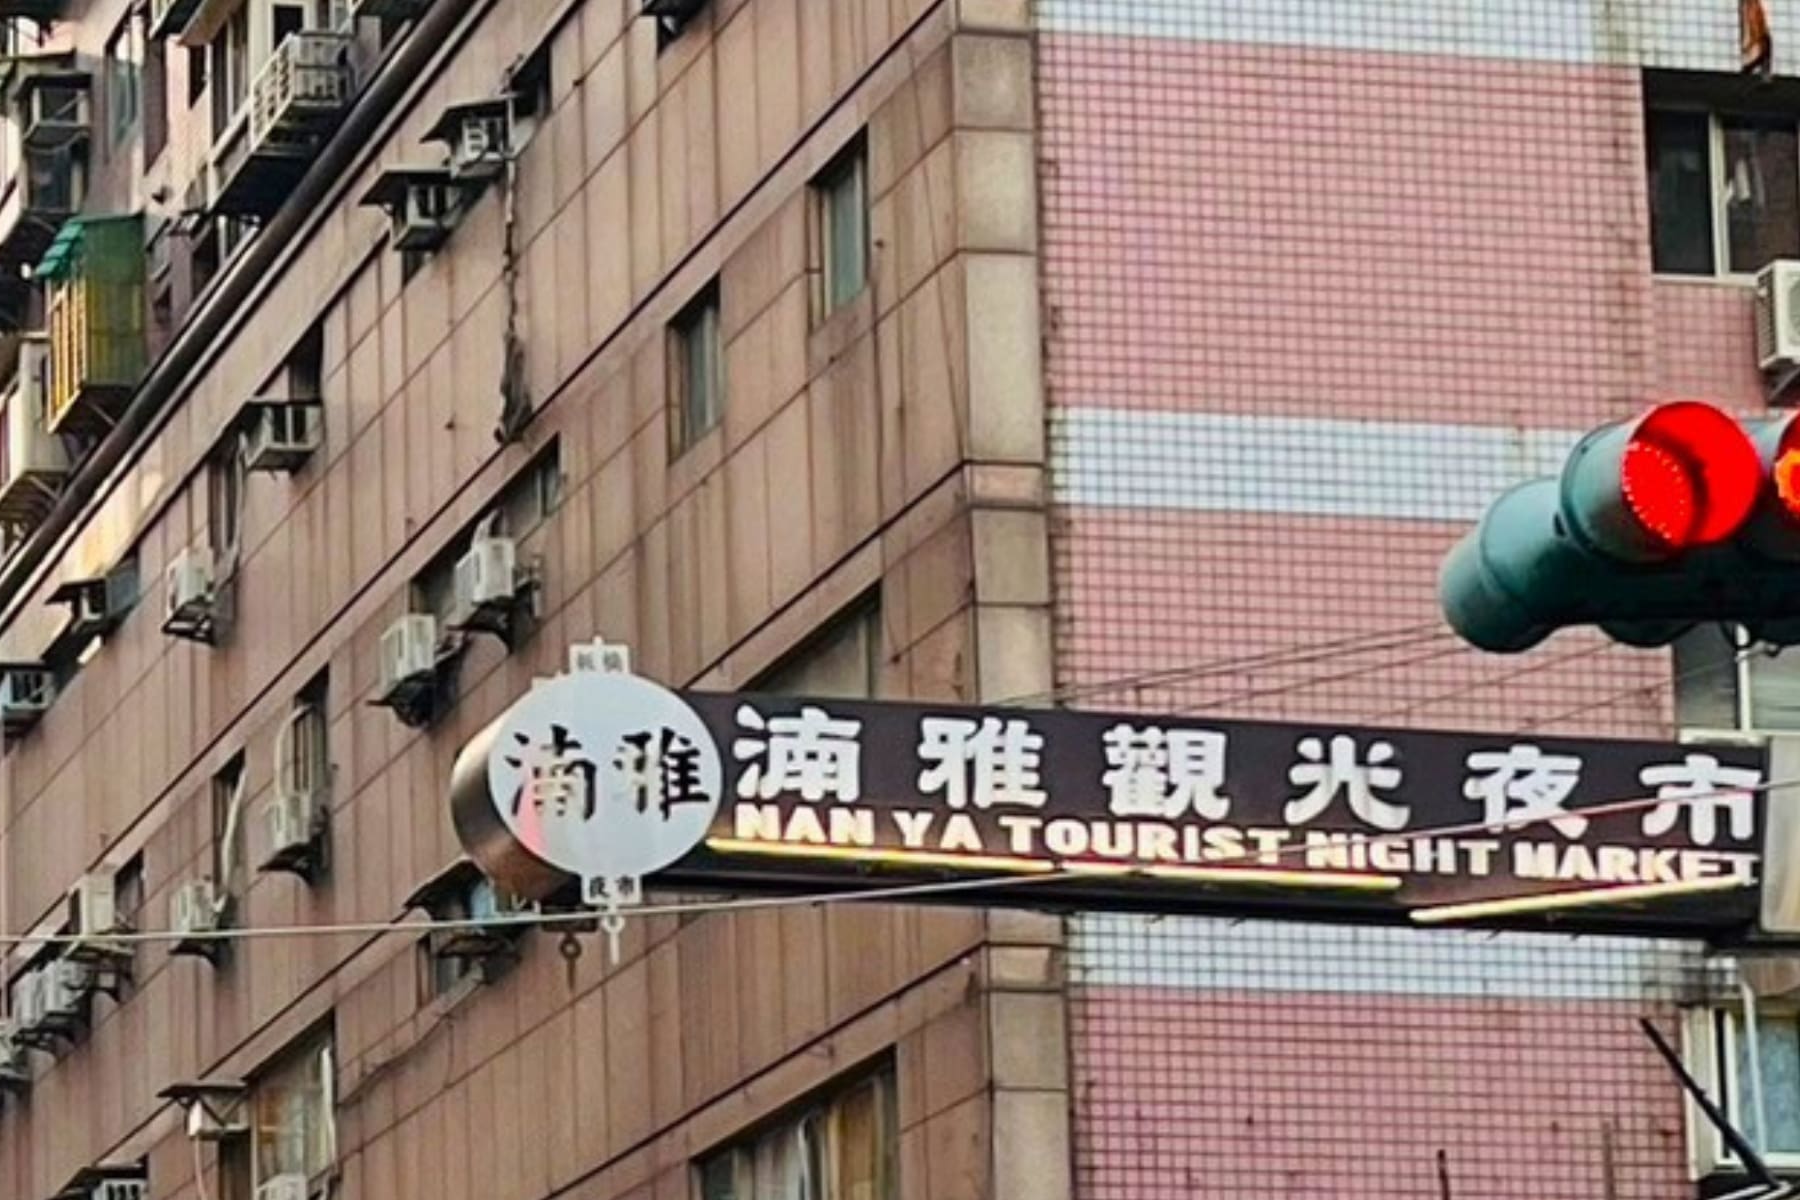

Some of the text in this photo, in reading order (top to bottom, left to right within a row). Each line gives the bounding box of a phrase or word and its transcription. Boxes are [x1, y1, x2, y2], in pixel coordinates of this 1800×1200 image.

[504, 723, 712, 822] 湳雅
[732, 704, 1762, 846] 湳雅觀光夜市
[734, 803, 876, 847] NAN
[892, 808, 983, 851] YA
[999, 815, 1290, 864] TOURIST
[1511, 842, 1758, 888] MARKET
